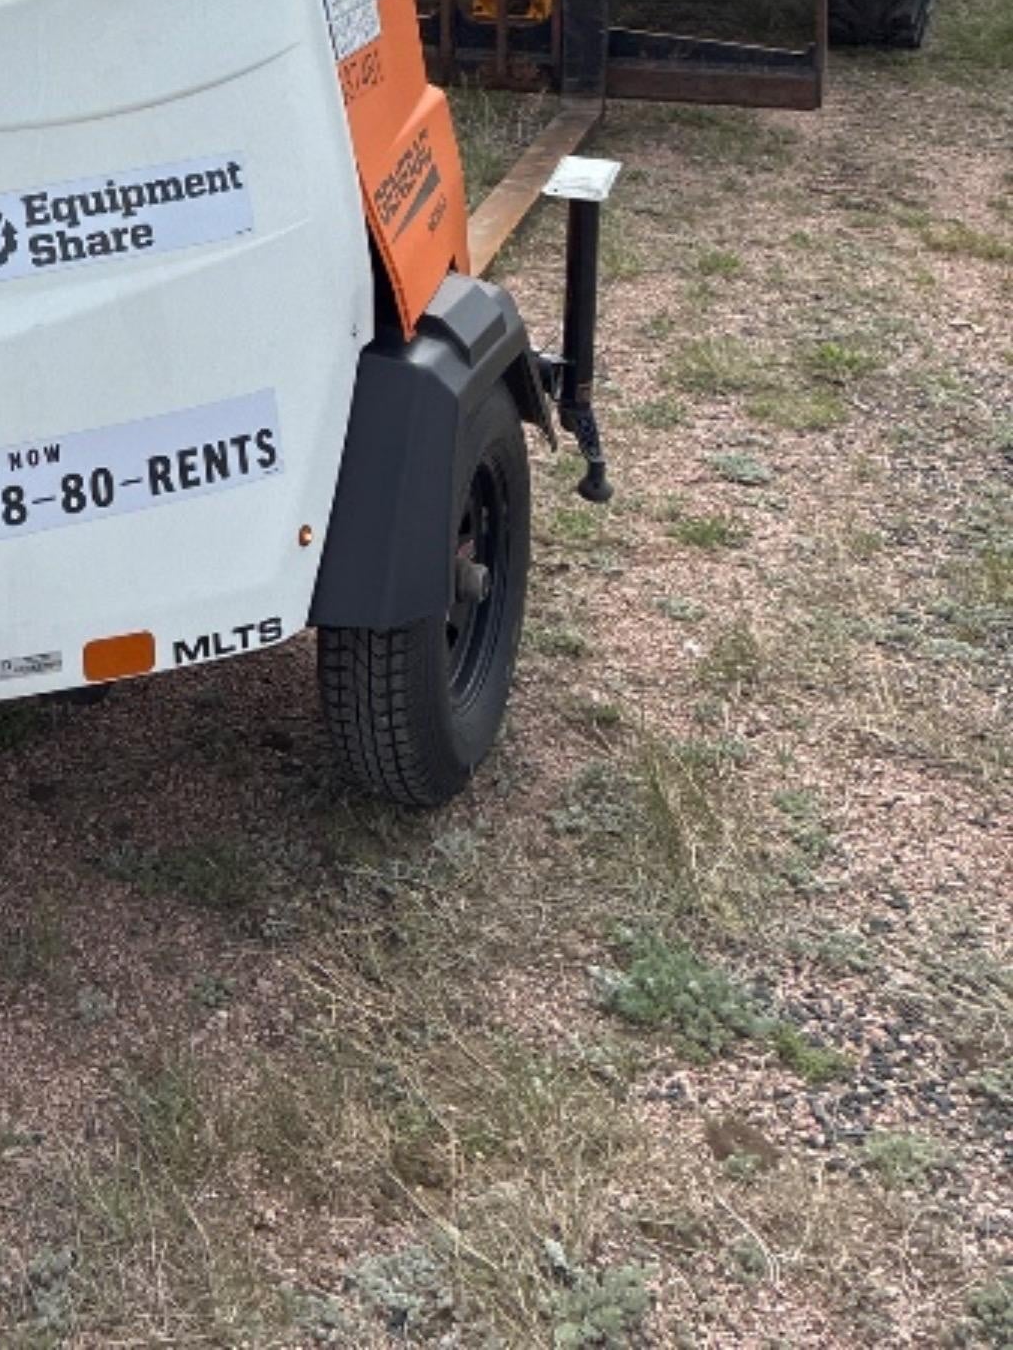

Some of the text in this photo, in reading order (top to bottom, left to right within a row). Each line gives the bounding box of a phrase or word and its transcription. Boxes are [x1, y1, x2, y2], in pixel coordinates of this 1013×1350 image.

[21, 160, 243, 227] Equipment
[28, 223, 154, 267] Share
[8, 443, 62, 472] NOW
[172, 617, 283, 665] MLTS
